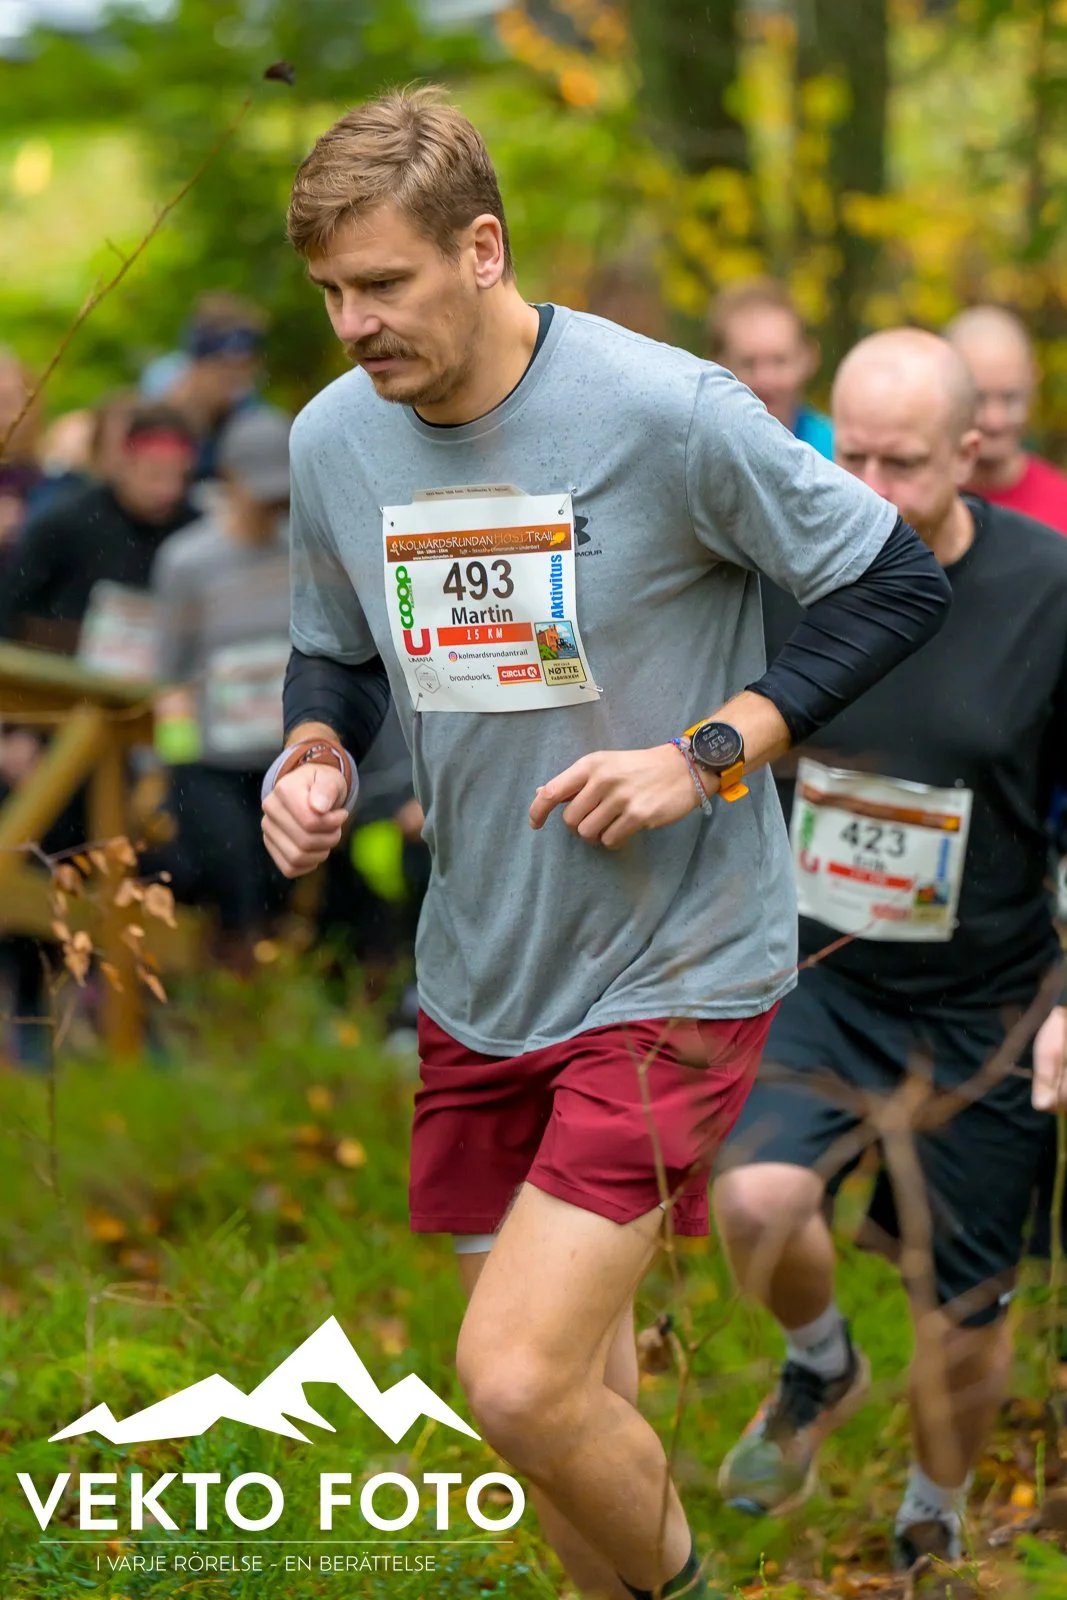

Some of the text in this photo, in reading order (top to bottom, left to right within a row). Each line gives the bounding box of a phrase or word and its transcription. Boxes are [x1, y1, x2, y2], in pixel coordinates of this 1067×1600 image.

[443, 559, 514, 601] 493
[549, 554, 565, 619] Aktivitus
[395, 565, 414, 629] coop
[451, 604, 514, 625] Martin
[466, 628, 503, 640] 15 KM
[458, 649, 529, 660] kolmardsrundantrail
[501, 669, 527, 678] CIRCLE
[548, 665, 579, 675] NØTTE
[840, 821, 906, 858] 423
